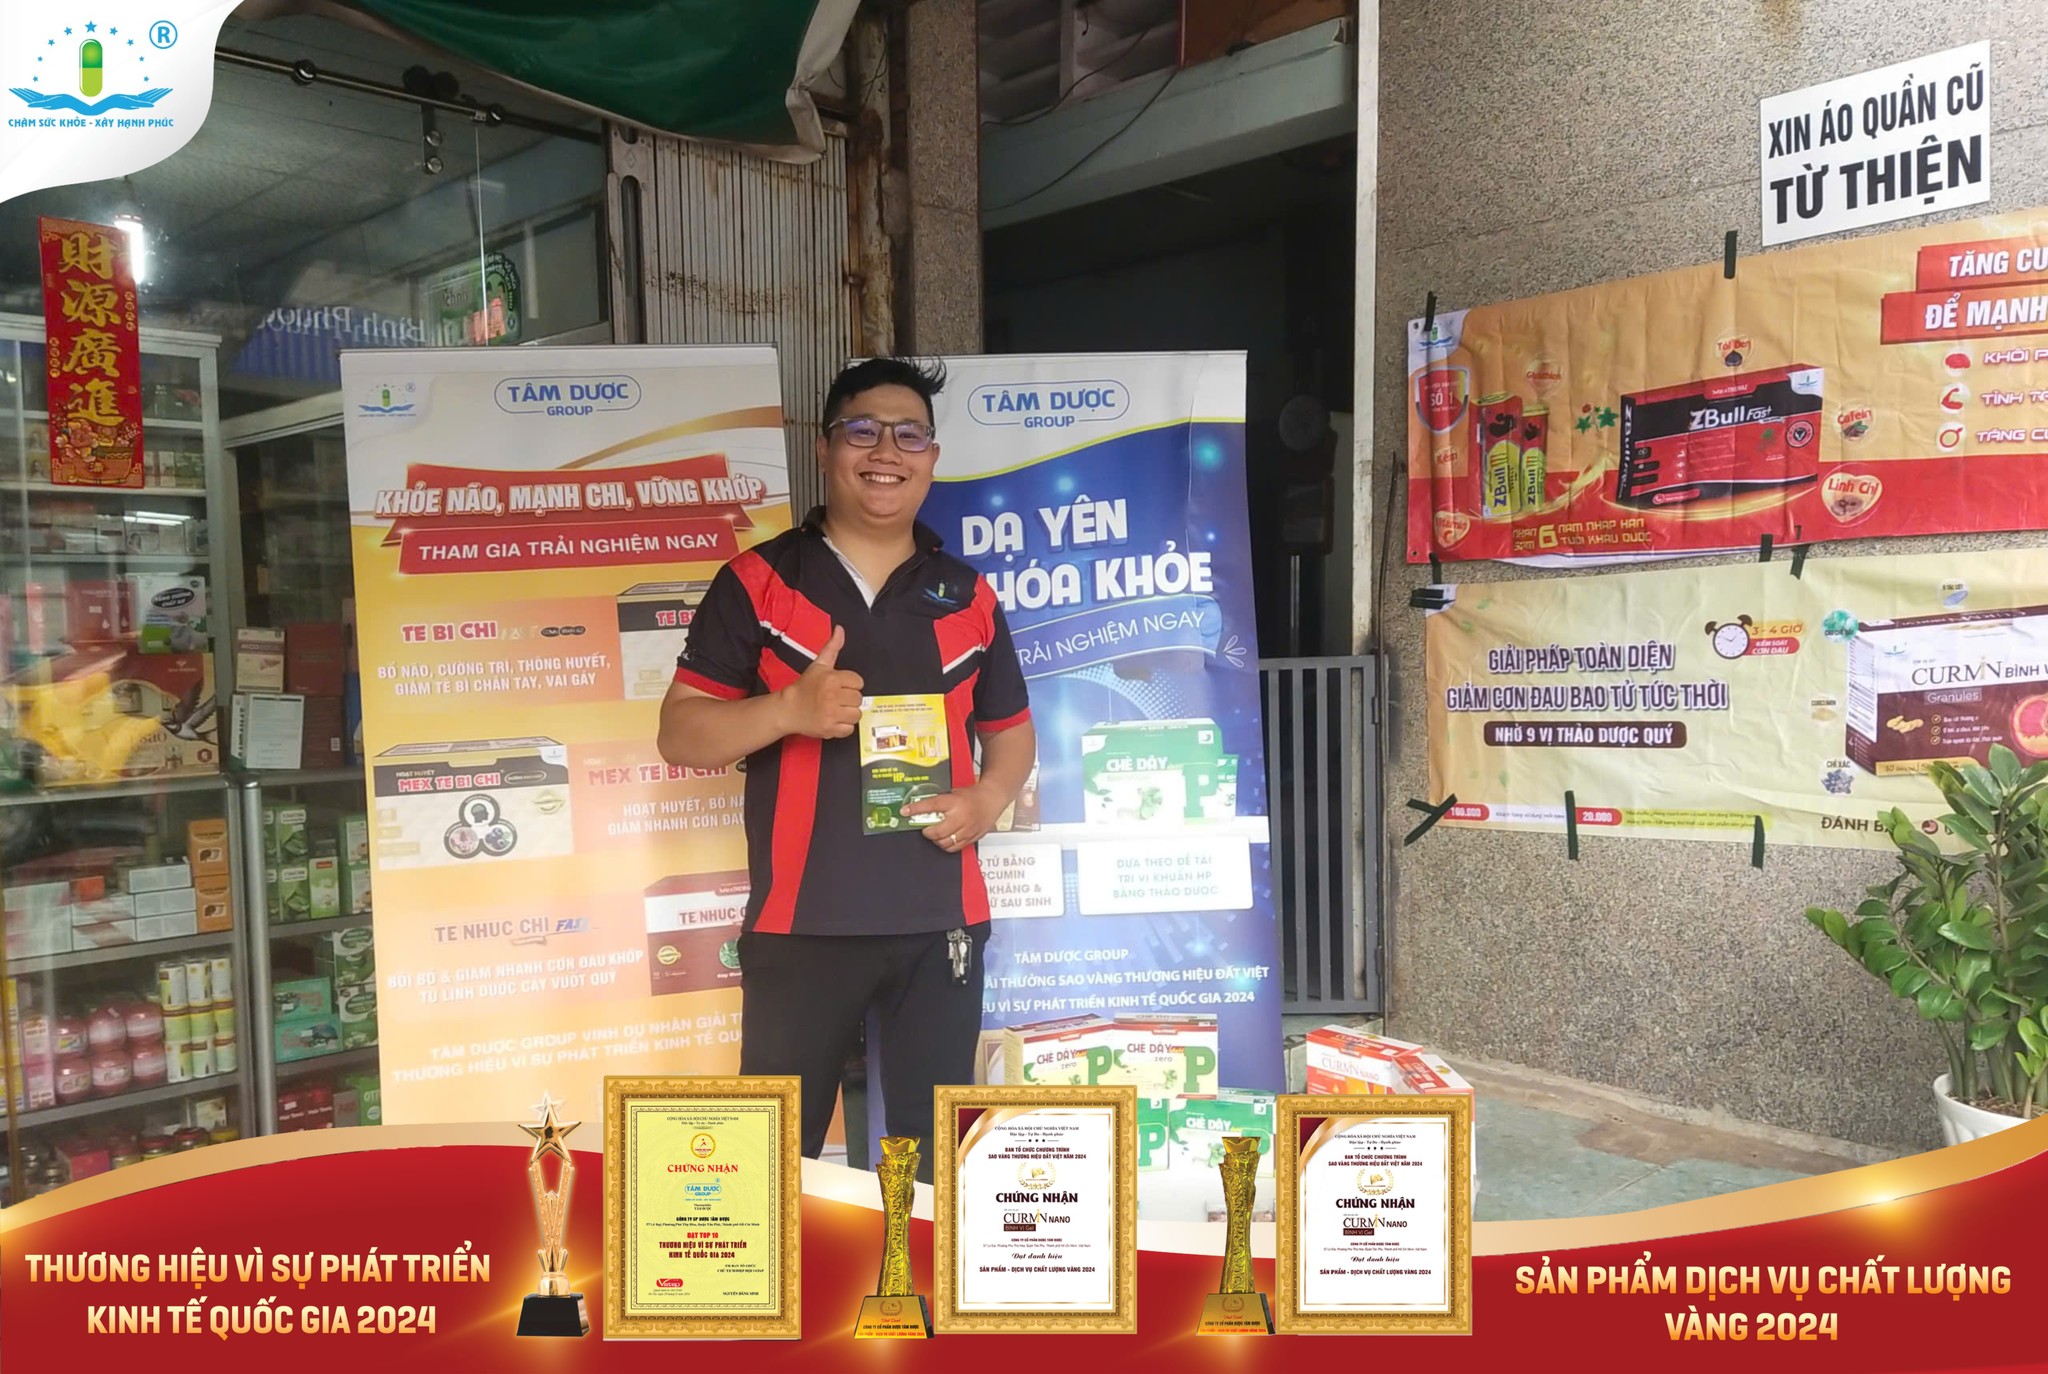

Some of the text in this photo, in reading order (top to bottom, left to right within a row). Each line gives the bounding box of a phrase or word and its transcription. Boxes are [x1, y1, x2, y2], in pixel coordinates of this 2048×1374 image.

[1768, 61, 1983, 159] XIN ÁO QUẦN CŨ
[1770, 134, 1982, 224] TỪ THIỆN
[1949, 249, 2010, 279] TĂNG
[1924, 292, 2047, 331] ĐỂ MẠNH
[58, 231, 127, 428] 財源廣進
[1983, 348, 2029, 365] KHÔI
[507, 382, 630, 404] TÂM DƯỢC
[982, 388, 1116, 413] TÂM DƯỢC
[1980, 389, 2024, 406] TỈNH
[546, 404, 594, 417] GROUP
[1024, 415, 1075, 429] GROUP
[1689, 404, 1746, 432] ZBull
[1836, 407, 1873, 426] Cafein
[1977, 427, 2026, 443] TĂNG
[374, 473, 765, 518] KHỎE NÃO, MẠNH CHI, VỮNG KHỚP
[1827, 478, 1854, 494] Linh
[961, 494, 1129, 563] DẠ YÊN
[1538, 524, 1558, 549] 6
[419, 532, 720, 562] THAM GIA TRẢI NGHIỆM NGAY
[986, 540, 1214, 612] HÓA KHỎE
[401, 624, 427, 643] TE
[431, 623, 456, 642] BI
[459, 620, 499, 641] CHI
[1015, 609, 1206, 666] RẢI NGHIỆM NGAY
[1752, 623, 1804, 635] 3 4 GIỜ
[565, 652, 611, 670] HUYẾT,
[1488, 640, 1674, 674] GIẢI PHÁP TOÀN DIỆN
[2005, 662, 2039, 679] BÌNH
[1446, 678, 1730, 710] GIẢM CƠN ĐAU BAO TỬ TỨC THỜI
[1927, 689, 1979, 704] Granules
[1495, 723, 1674, 748] NHỜ 9 VỊ THẢO DƯỢC QUÝ
[398, 777, 434, 793] MEX
[435, 775, 454, 790] TE
[455, 774, 473, 789] BI
[474, 772, 501, 787] CHI
[1821, 815, 1869, 832] ĐÁNH
[434, 917, 550, 943] TE NHUC CHI
[1015, 949, 1129, 965] TÂM DƯỢC GROUP
[1000, 965, 1269, 988] THƯỞNG SAO VÀNG THƯƠNG HIỆU ĐẤT VIỆT
[999, 991, 1255, 1014] VÌ SỰ PHÁT TRIỂN KINH TẾ QUỐC GIA 2024
